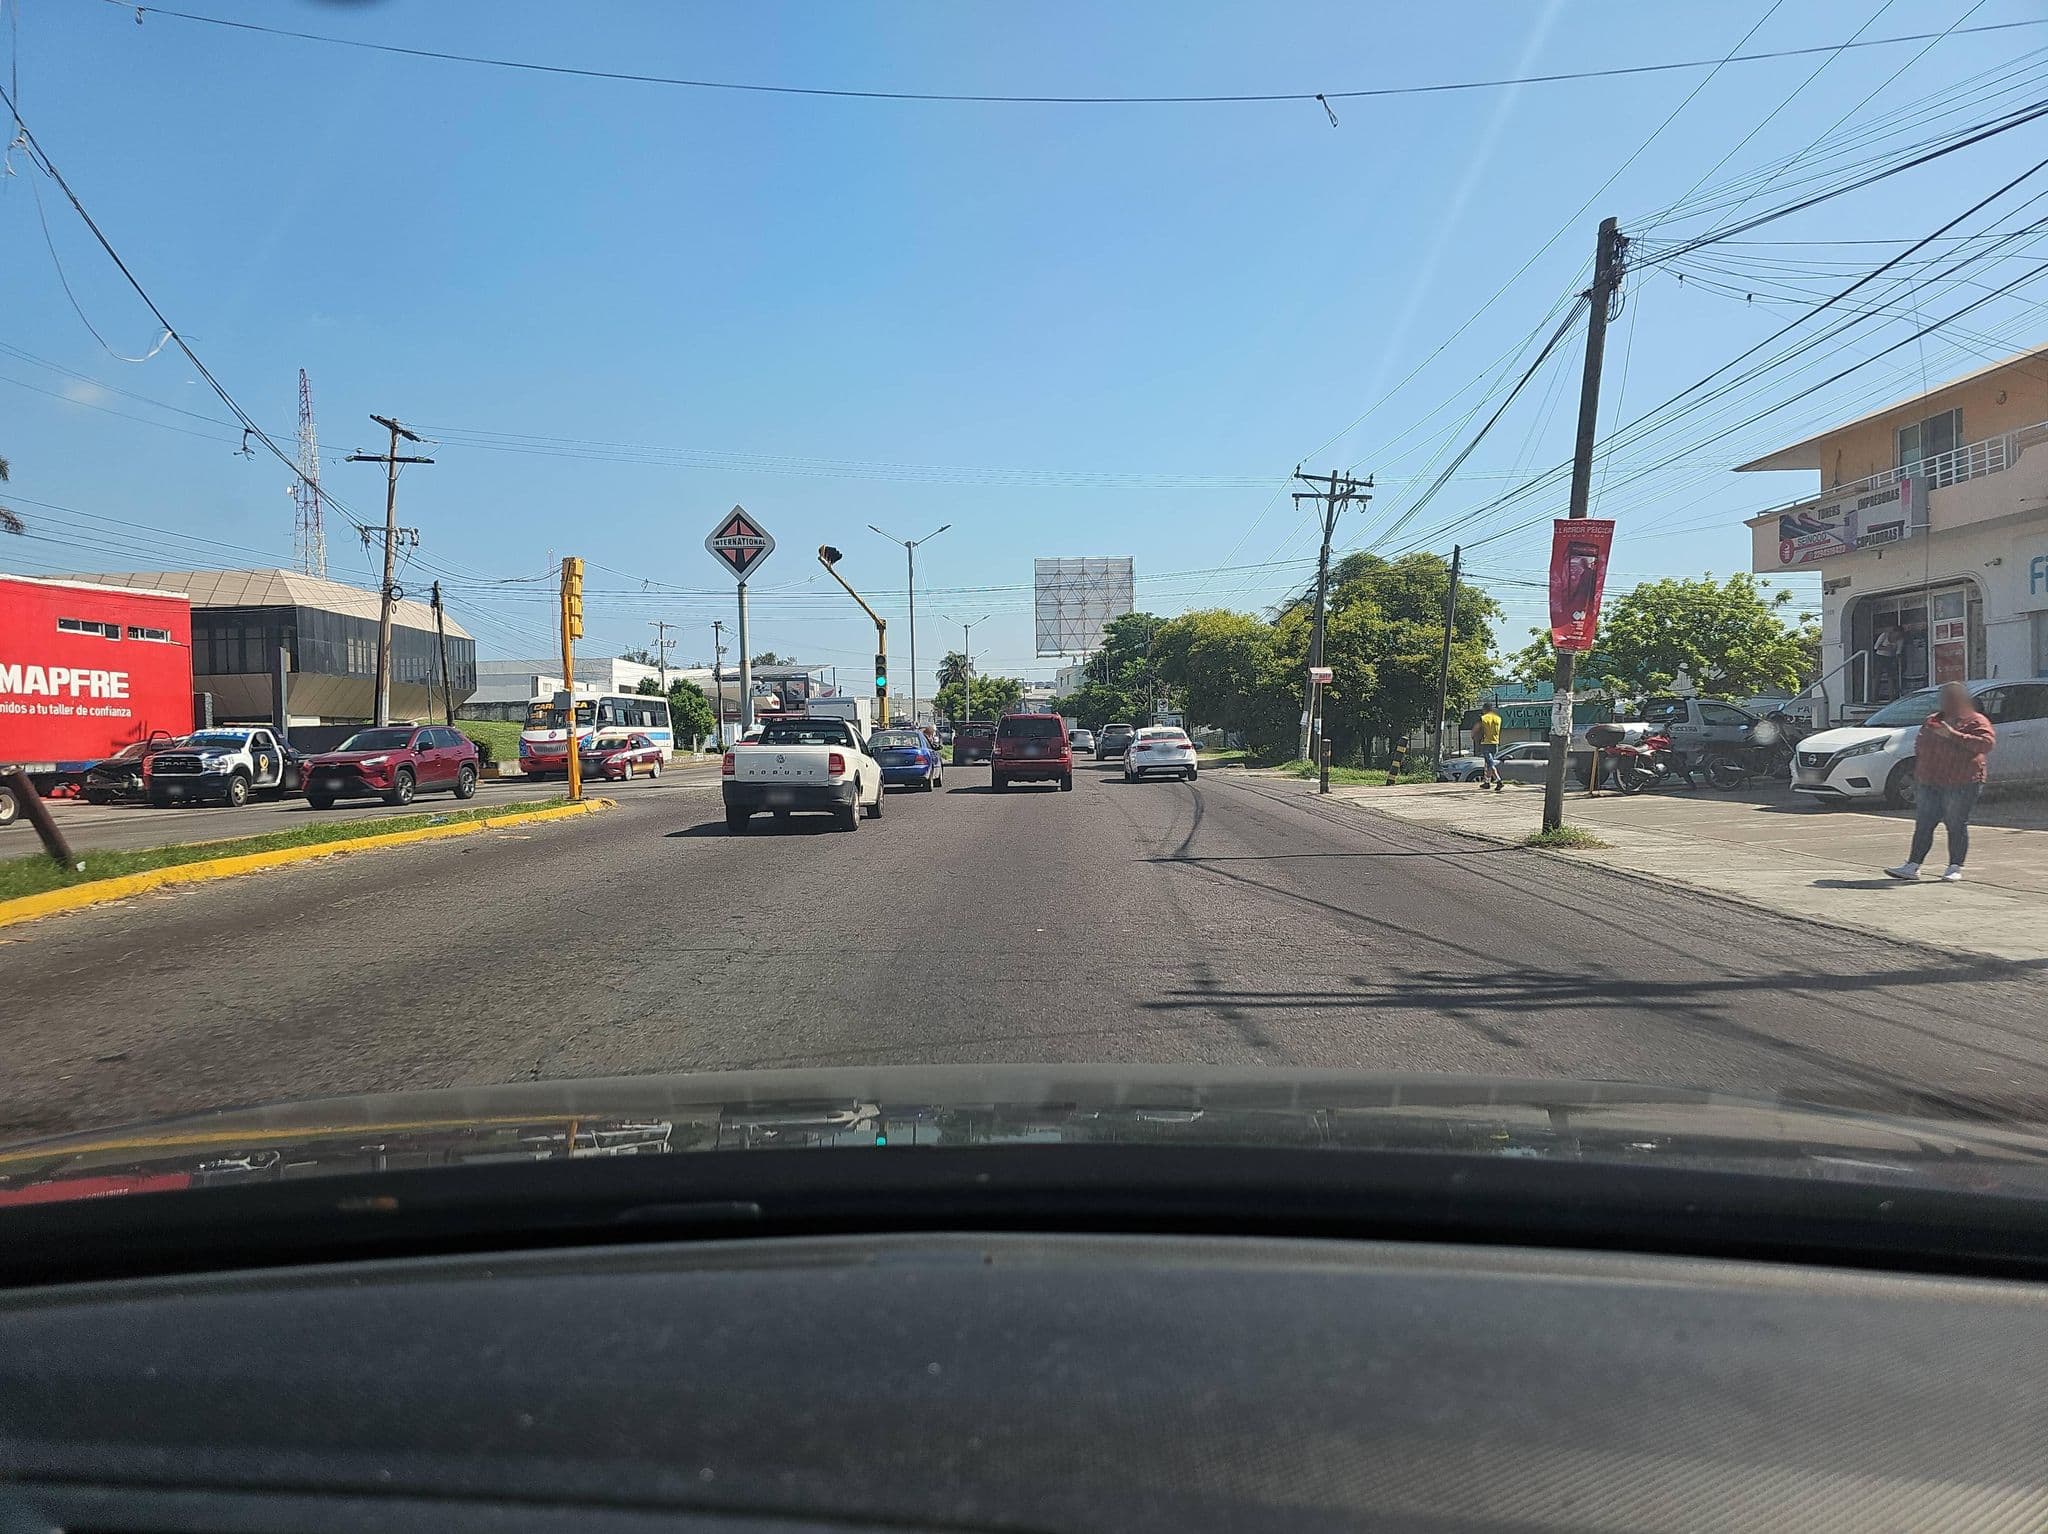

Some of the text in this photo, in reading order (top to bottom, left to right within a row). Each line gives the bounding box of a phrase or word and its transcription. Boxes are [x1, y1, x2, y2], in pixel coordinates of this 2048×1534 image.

[1858, 488, 1900, 510] IMPRESORAS
[712, 537, 766, 546] INTERNATIONAL
[1857, 528, 1898, 548] COPIADORAS
[0, 662, 130, 699] MAPFRE
[0, 701, 132, 718] nidos a tu taller de confianza
